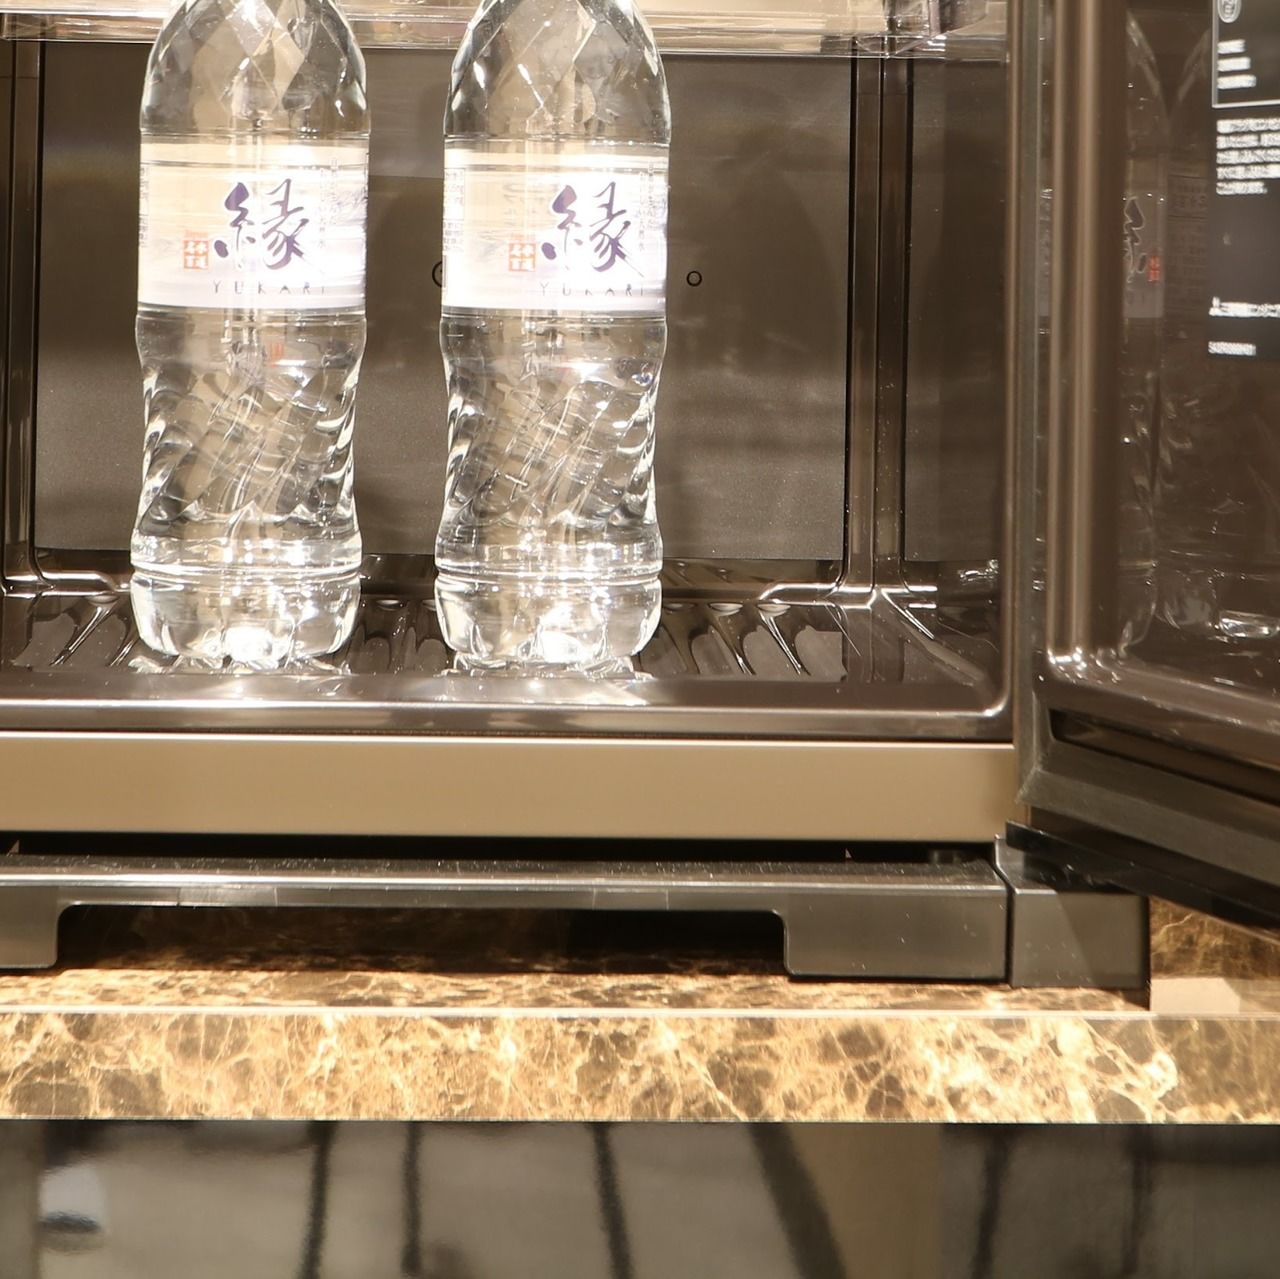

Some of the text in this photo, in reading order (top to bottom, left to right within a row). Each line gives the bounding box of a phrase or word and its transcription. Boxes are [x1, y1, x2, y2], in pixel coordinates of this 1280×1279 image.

[214, 178, 310, 271] 縁
[541, 181, 642, 276] 縁
[213, 280, 326, 295] YUKARI
